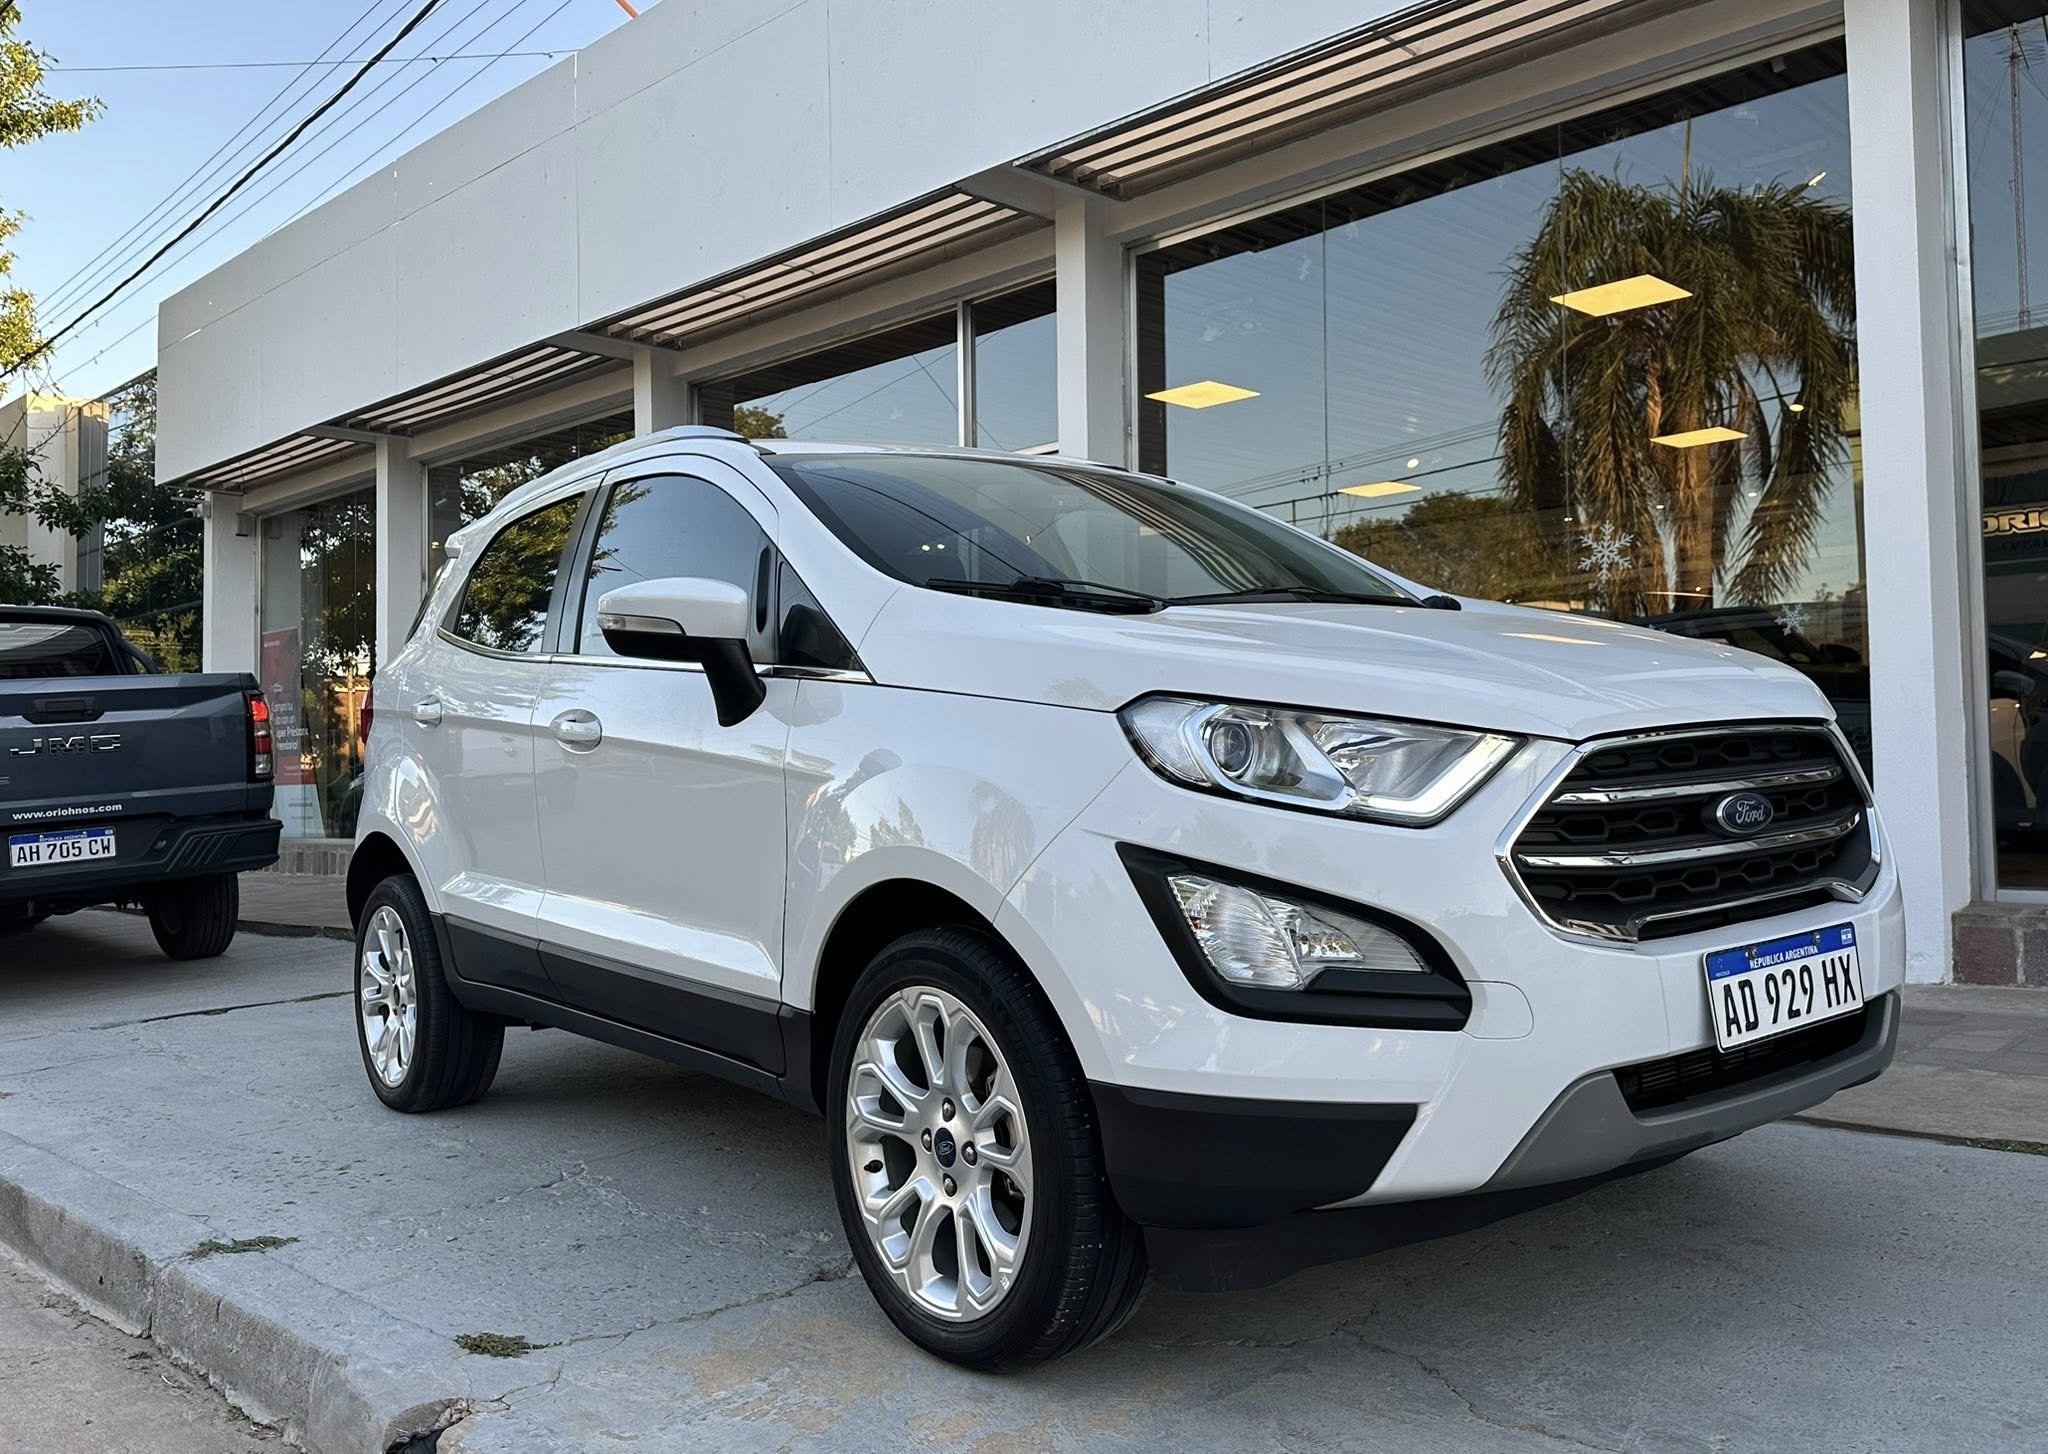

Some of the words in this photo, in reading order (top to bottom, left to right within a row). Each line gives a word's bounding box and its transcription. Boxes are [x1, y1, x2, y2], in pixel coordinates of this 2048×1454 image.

[10, 735, 120, 757] JMC
[12, 804, 122, 820] www.oriohnos.com
[1736, 800, 1765, 824] Ford
[17, 844, 40, 863] AH
[47, 841, 82, 860] 705
[88, 838, 111, 855] CW
[1749, 953, 1784, 969] REPUBLICA
[1785, 945, 1819, 961] ARGENTINA
[1723, 979, 1759, 1037] AD
[1764, 965, 1814, 1024] 929
[1821, 953, 1857, 1008] HX
